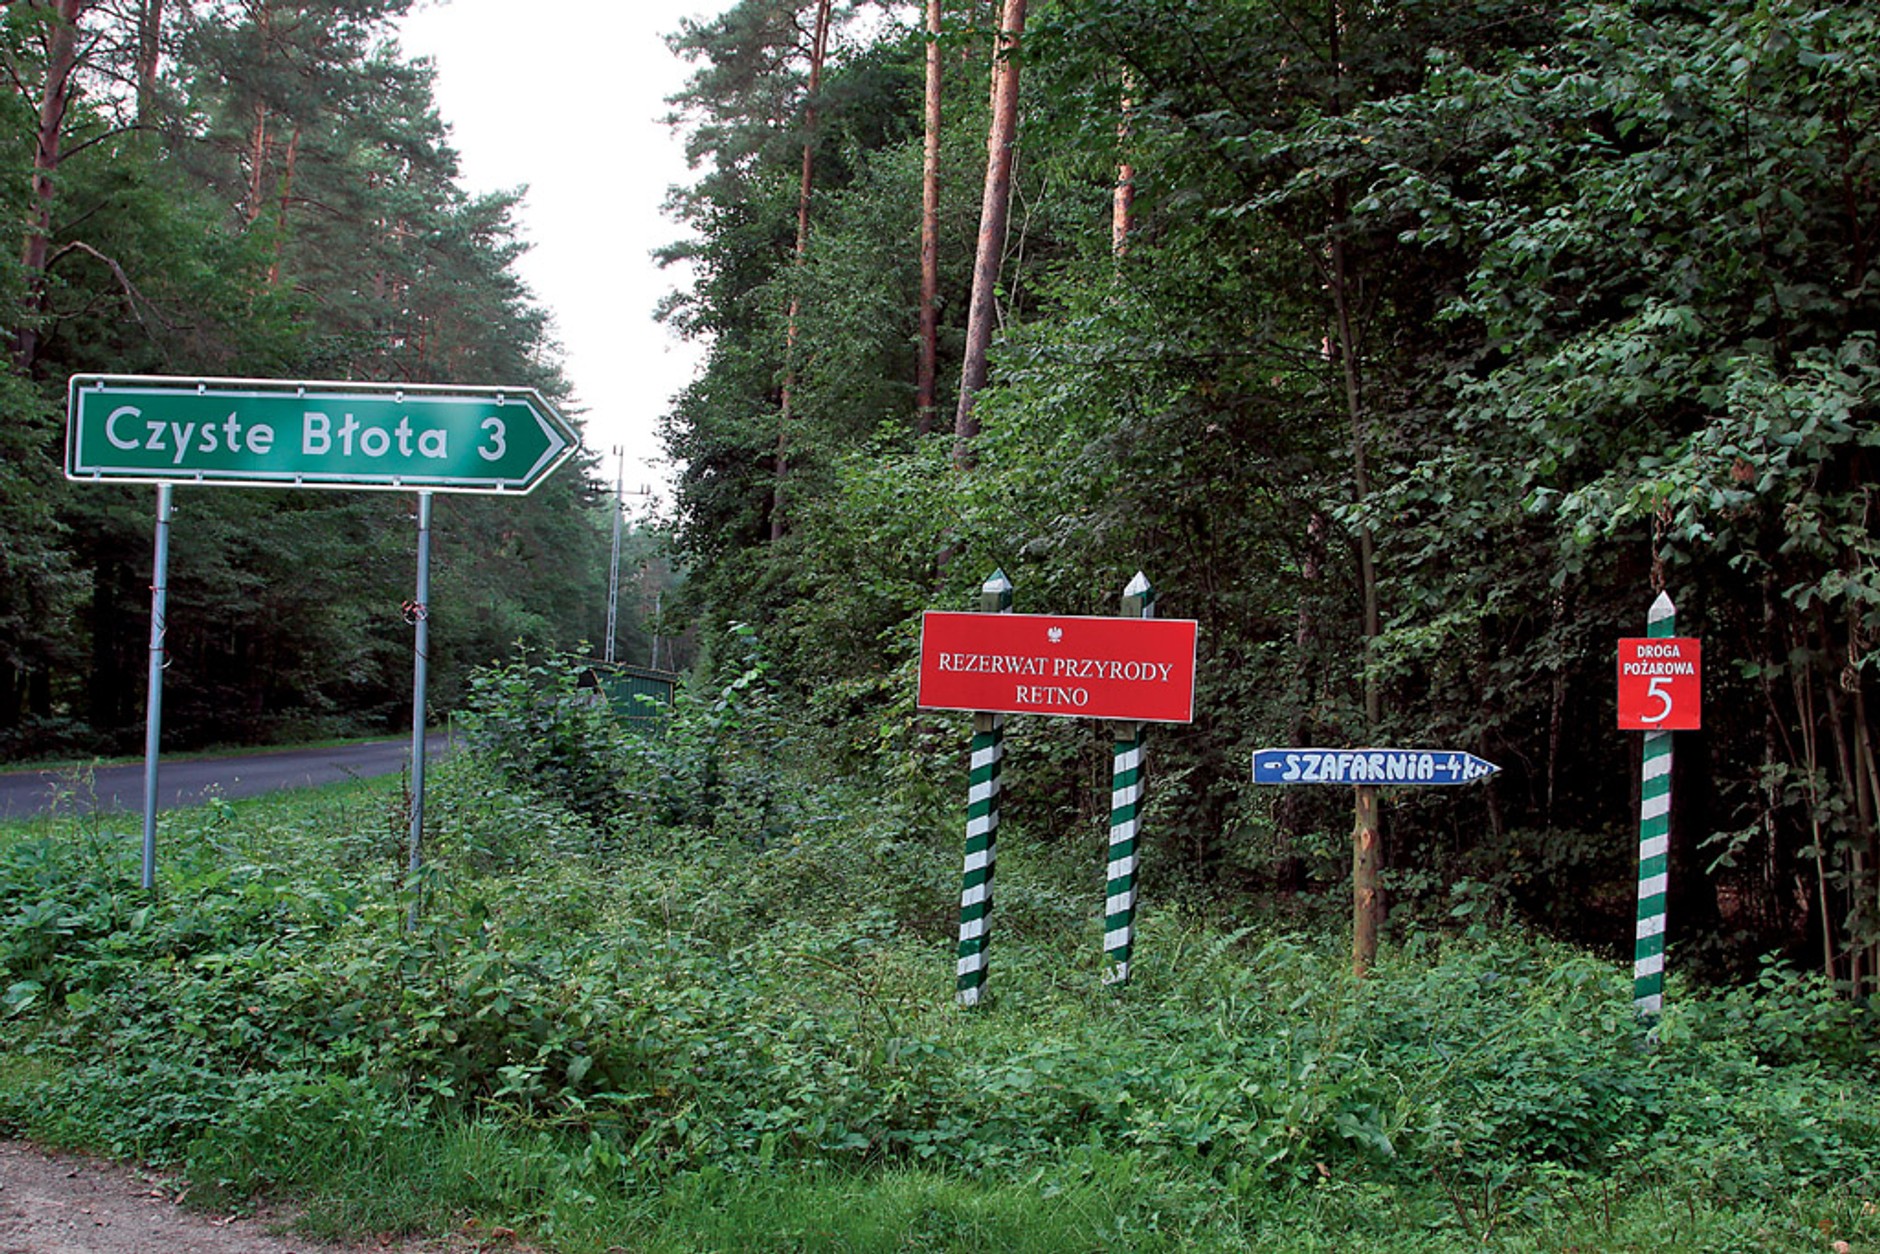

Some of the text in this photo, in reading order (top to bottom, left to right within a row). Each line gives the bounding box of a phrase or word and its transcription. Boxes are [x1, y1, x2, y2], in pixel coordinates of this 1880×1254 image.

[105, 405, 507, 465] Czyste Błota 3
[1636, 644, 1681, 659] DROGA
[938, 652, 1174, 682] REZERWAT PRZYRODY
[1623, 658, 1695, 676] POŻAROWA
[1015, 684, 1090, 707] RETNO
[1640, 676, 1673, 723] 5
